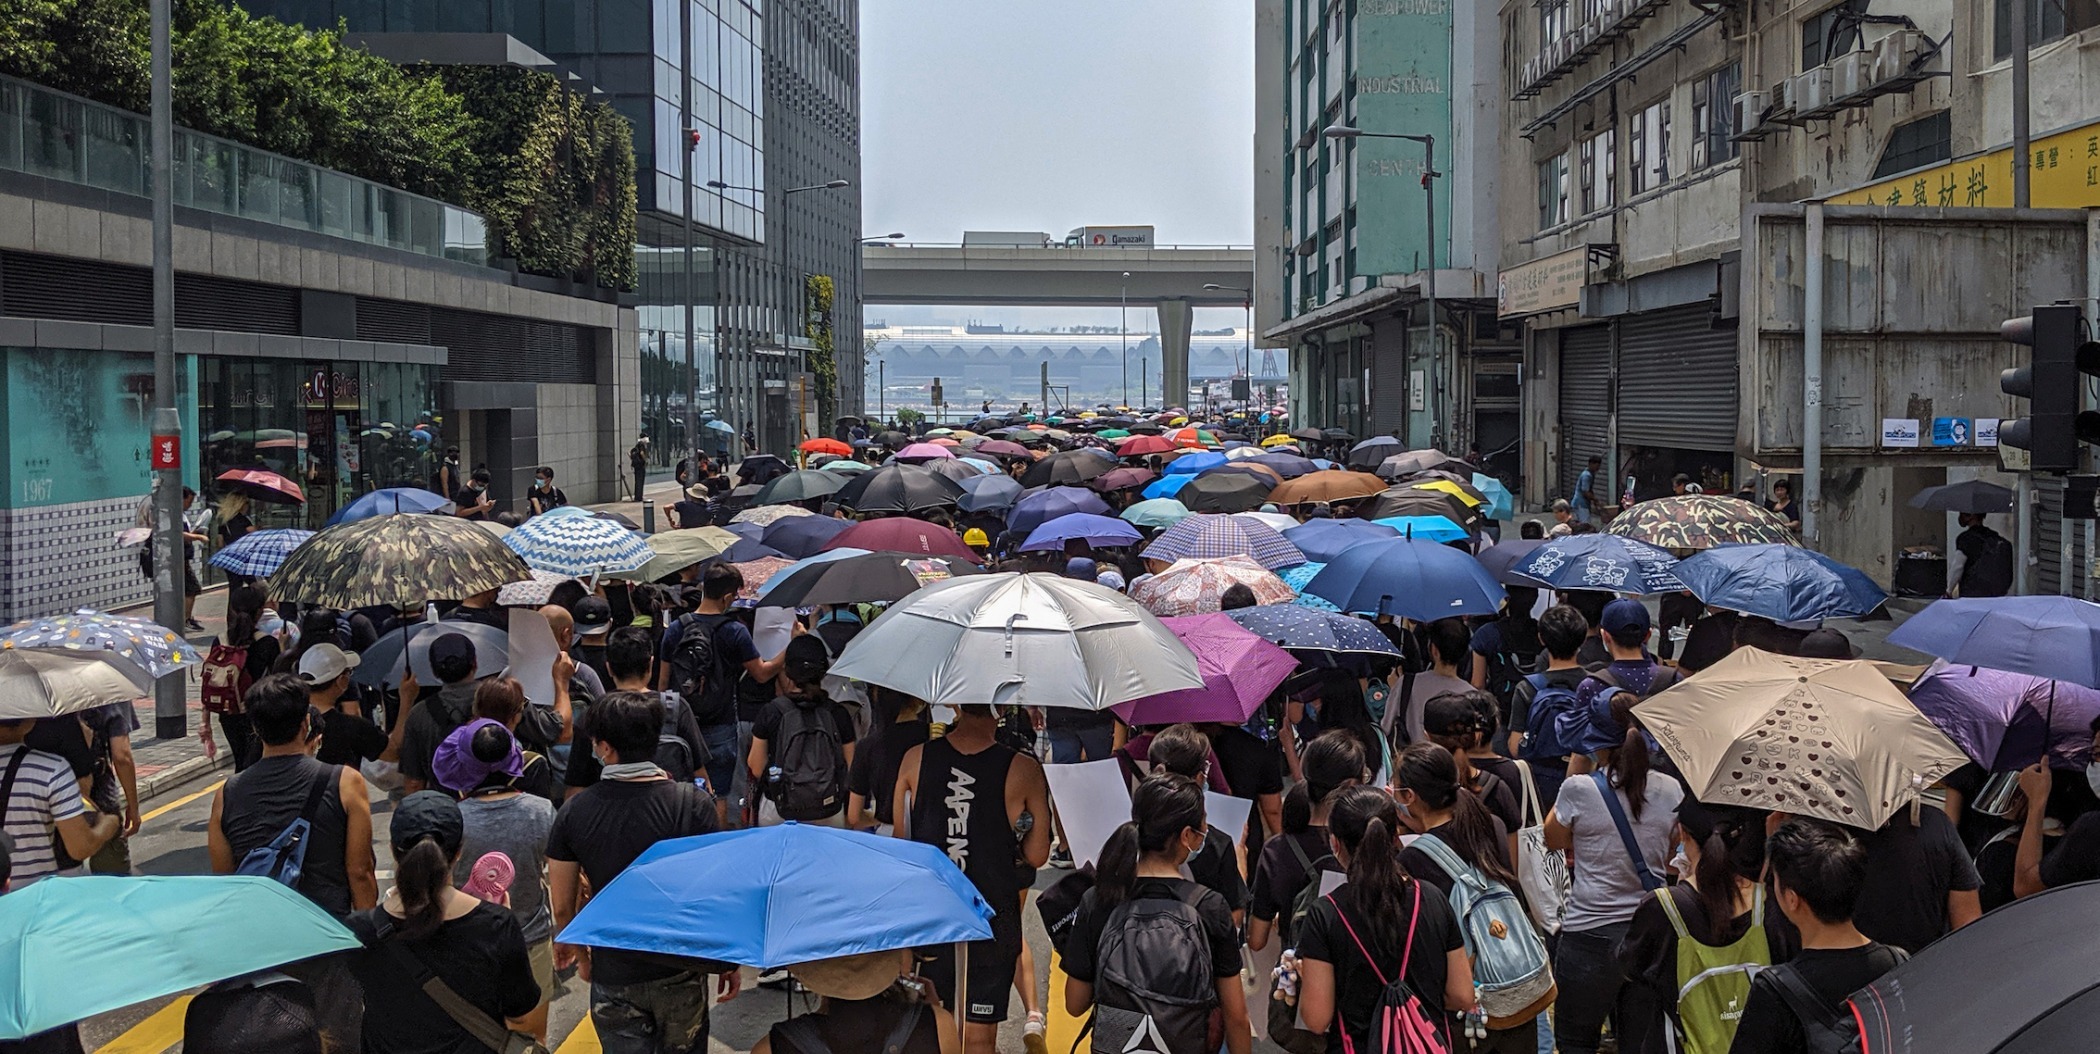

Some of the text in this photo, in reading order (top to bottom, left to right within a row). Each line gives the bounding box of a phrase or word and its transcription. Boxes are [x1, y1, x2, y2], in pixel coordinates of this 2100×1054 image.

[1363, 0, 1447, 15] SEAPOWER
[1358, 76, 1445, 94] INDUSTRIAL
[24, 479, 52, 502] 1967
